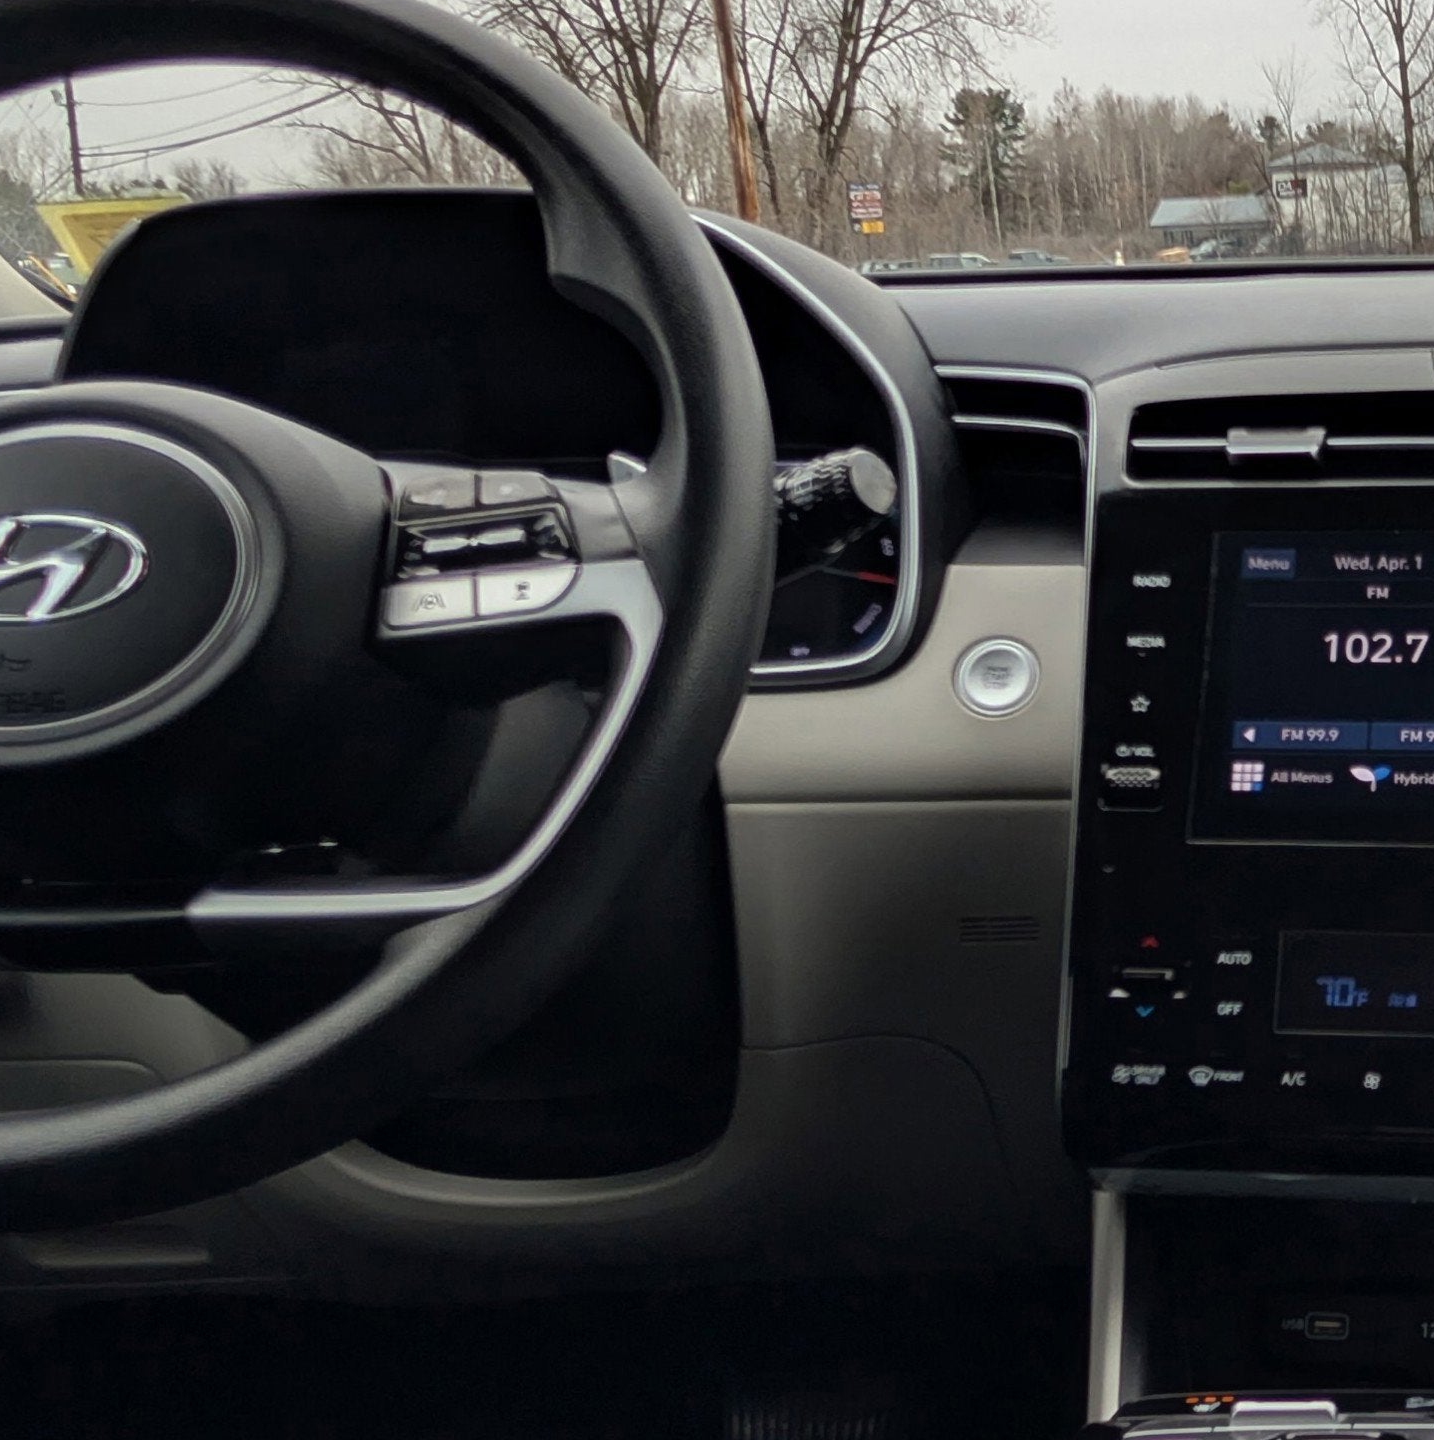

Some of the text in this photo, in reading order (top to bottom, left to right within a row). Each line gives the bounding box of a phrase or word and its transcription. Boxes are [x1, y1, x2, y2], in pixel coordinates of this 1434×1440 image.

[1247, 555, 1291, 571] Menu
[1377, 554, 1411, 575] Apr.
[1414, 555, 1423, 571] 1
[1365, 585, 1391, 600] FM
[1323, 631, 1430, 664] 102.7
[1280, 728, 1340, 743] FM 99.9
[1399, 729, 1424, 744] FM
[1270, 771, 1334, 785] All Menus
[1216, 950, 1254, 966] AUTO
[1215, 1000, 1245, 1017] OFF
[1280, 1071, 1308, 1088] A/C
